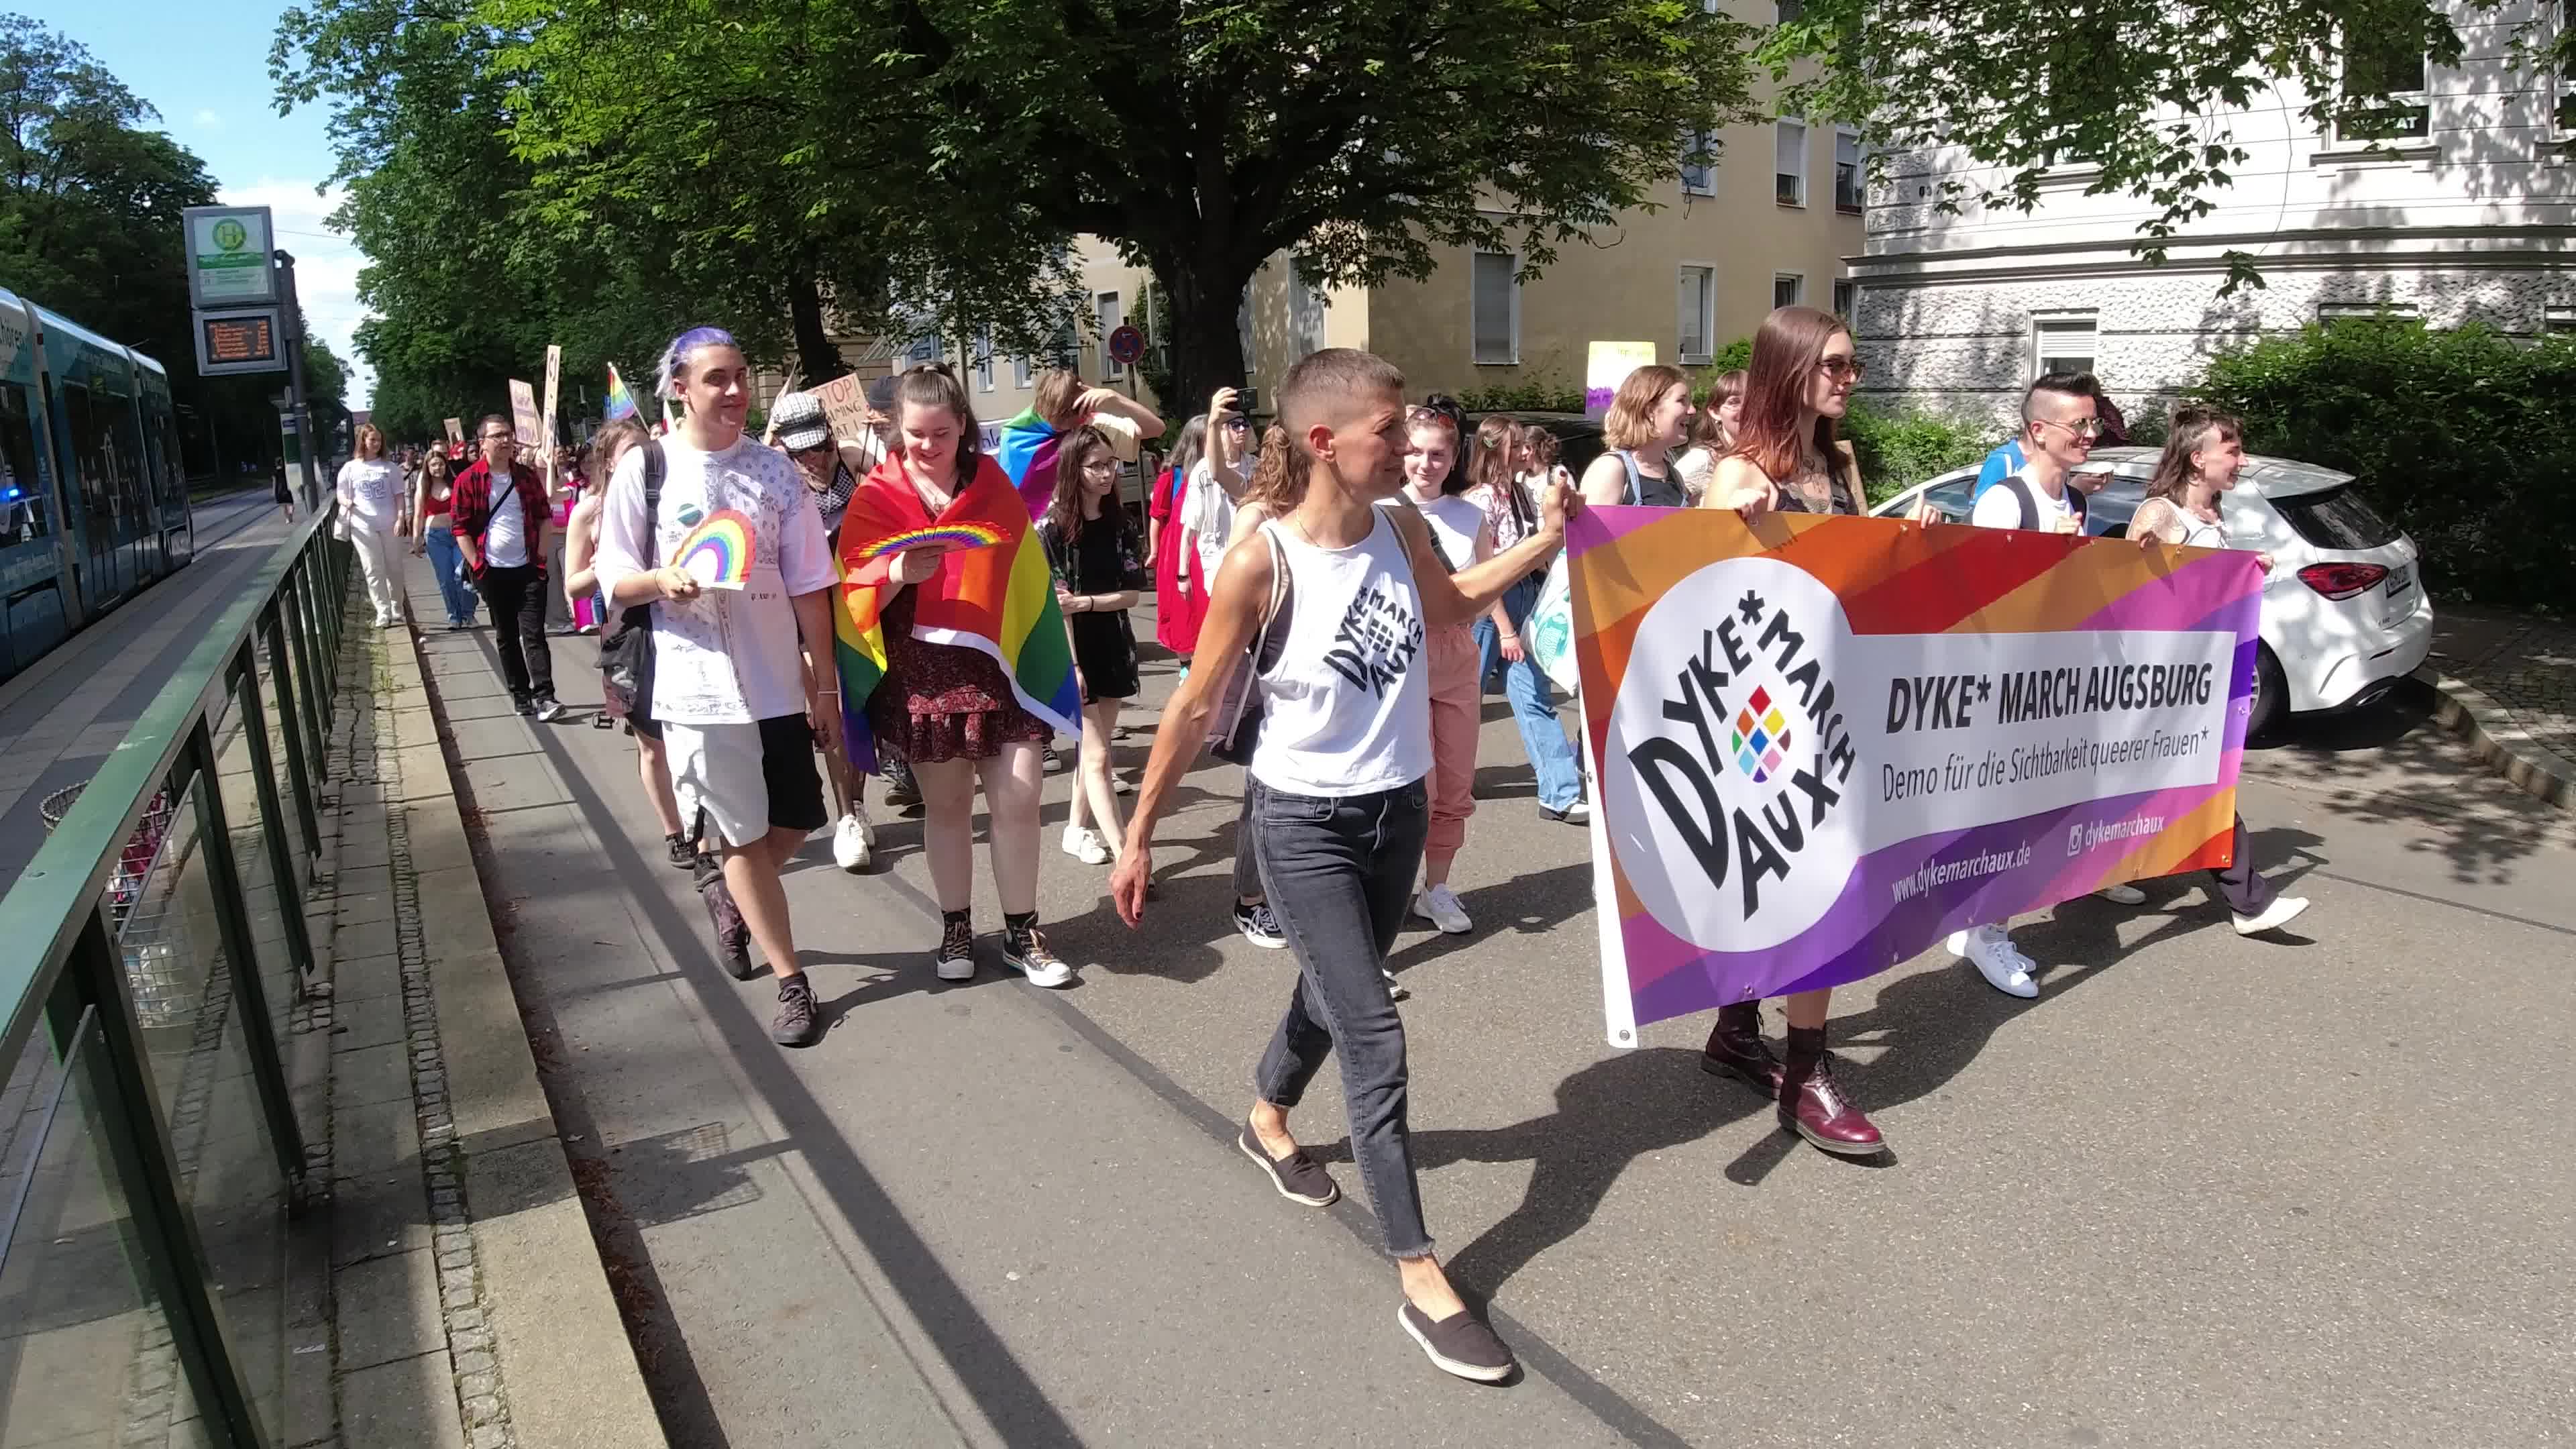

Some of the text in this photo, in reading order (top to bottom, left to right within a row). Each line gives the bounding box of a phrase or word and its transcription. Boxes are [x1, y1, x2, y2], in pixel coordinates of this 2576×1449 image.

[359, 479, 387, 500] 92
[1368, 588, 1423, 644] MARCH
[1370, 635, 1417, 700] AUX
[1756, 608, 1856, 785] MARCH
[1998, 667, 2081, 724] MARCH
[2083, 663, 2212, 714] AUGSBURG
[1883, 763, 1938, 802] Demo
[1944, 753, 1974, 792] für
[1978, 749, 2004, 788] die
[2009, 737, 2088, 784] Sichtbarkeit
[2090, 739, 2149, 775] queerer
[1733, 753, 1841, 922] AUX
[2085, 813, 2165, 853] dykemarchaux
[1892, 839, 2031, 904] www.dykemarchaux.de
